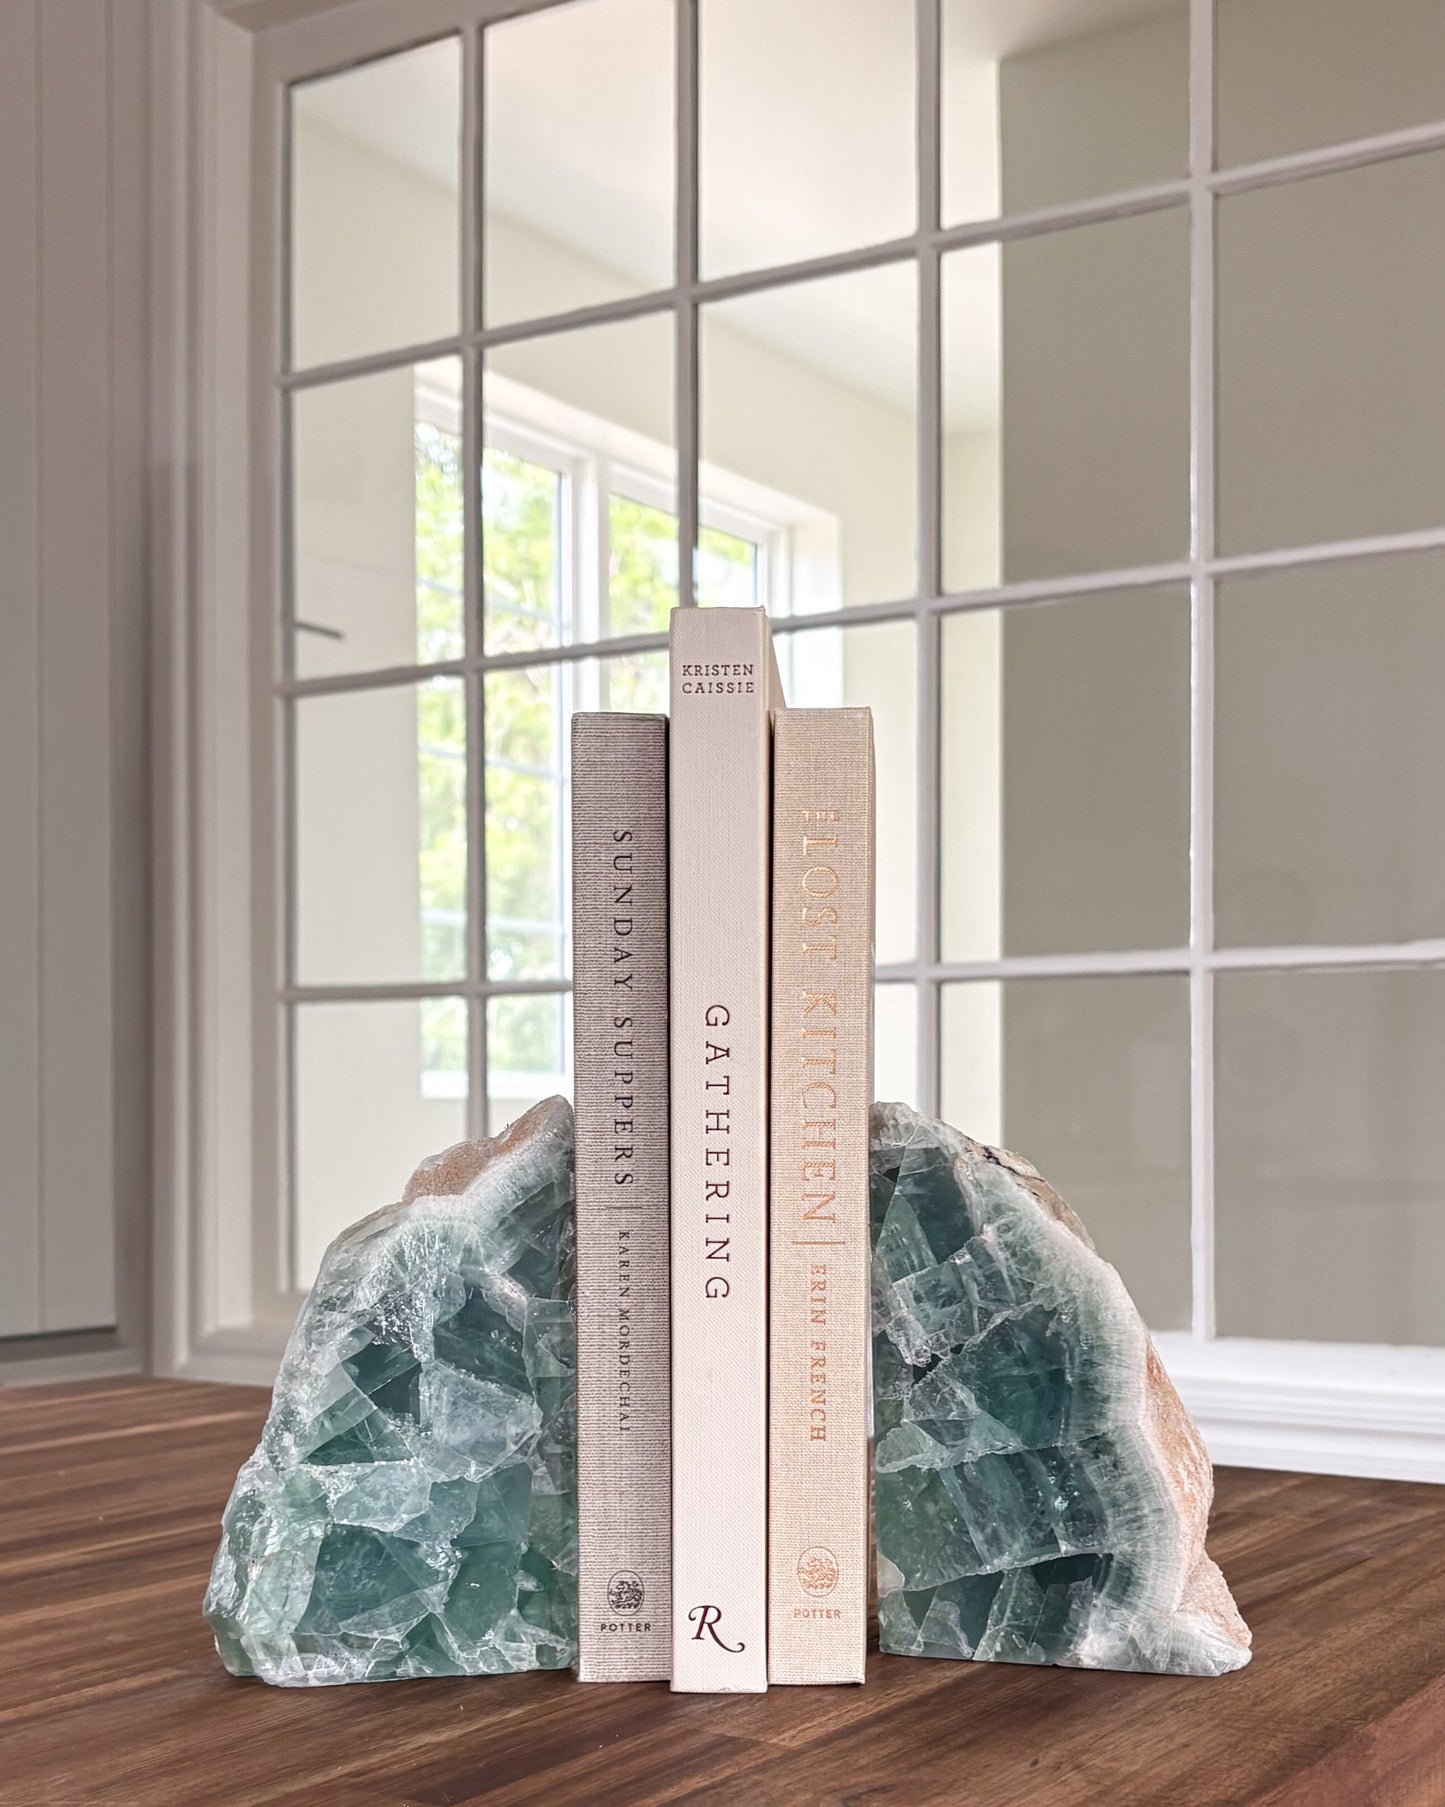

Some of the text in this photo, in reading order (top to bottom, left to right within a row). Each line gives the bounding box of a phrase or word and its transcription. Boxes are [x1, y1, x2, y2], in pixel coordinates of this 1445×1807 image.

[682, 664, 754, 677] KRISTEN
[682, 682, 755, 694] CAISSIE
[612, 829, 634, 1185] SUNDAY SUPPERS
[801, 836, 839, 1224] LOST KITCHEN
[704, 1004, 731, 1299] GATHERING
[618, 1231, 631, 1432] KAREN MORDECHAI
[809, 1264, 827, 1442] ERIN FRENCH
[600, 1622, 652, 1633] POTTER
[687, 1605, 746, 1653] R
[794, 1607, 842, 1620] POTTER
